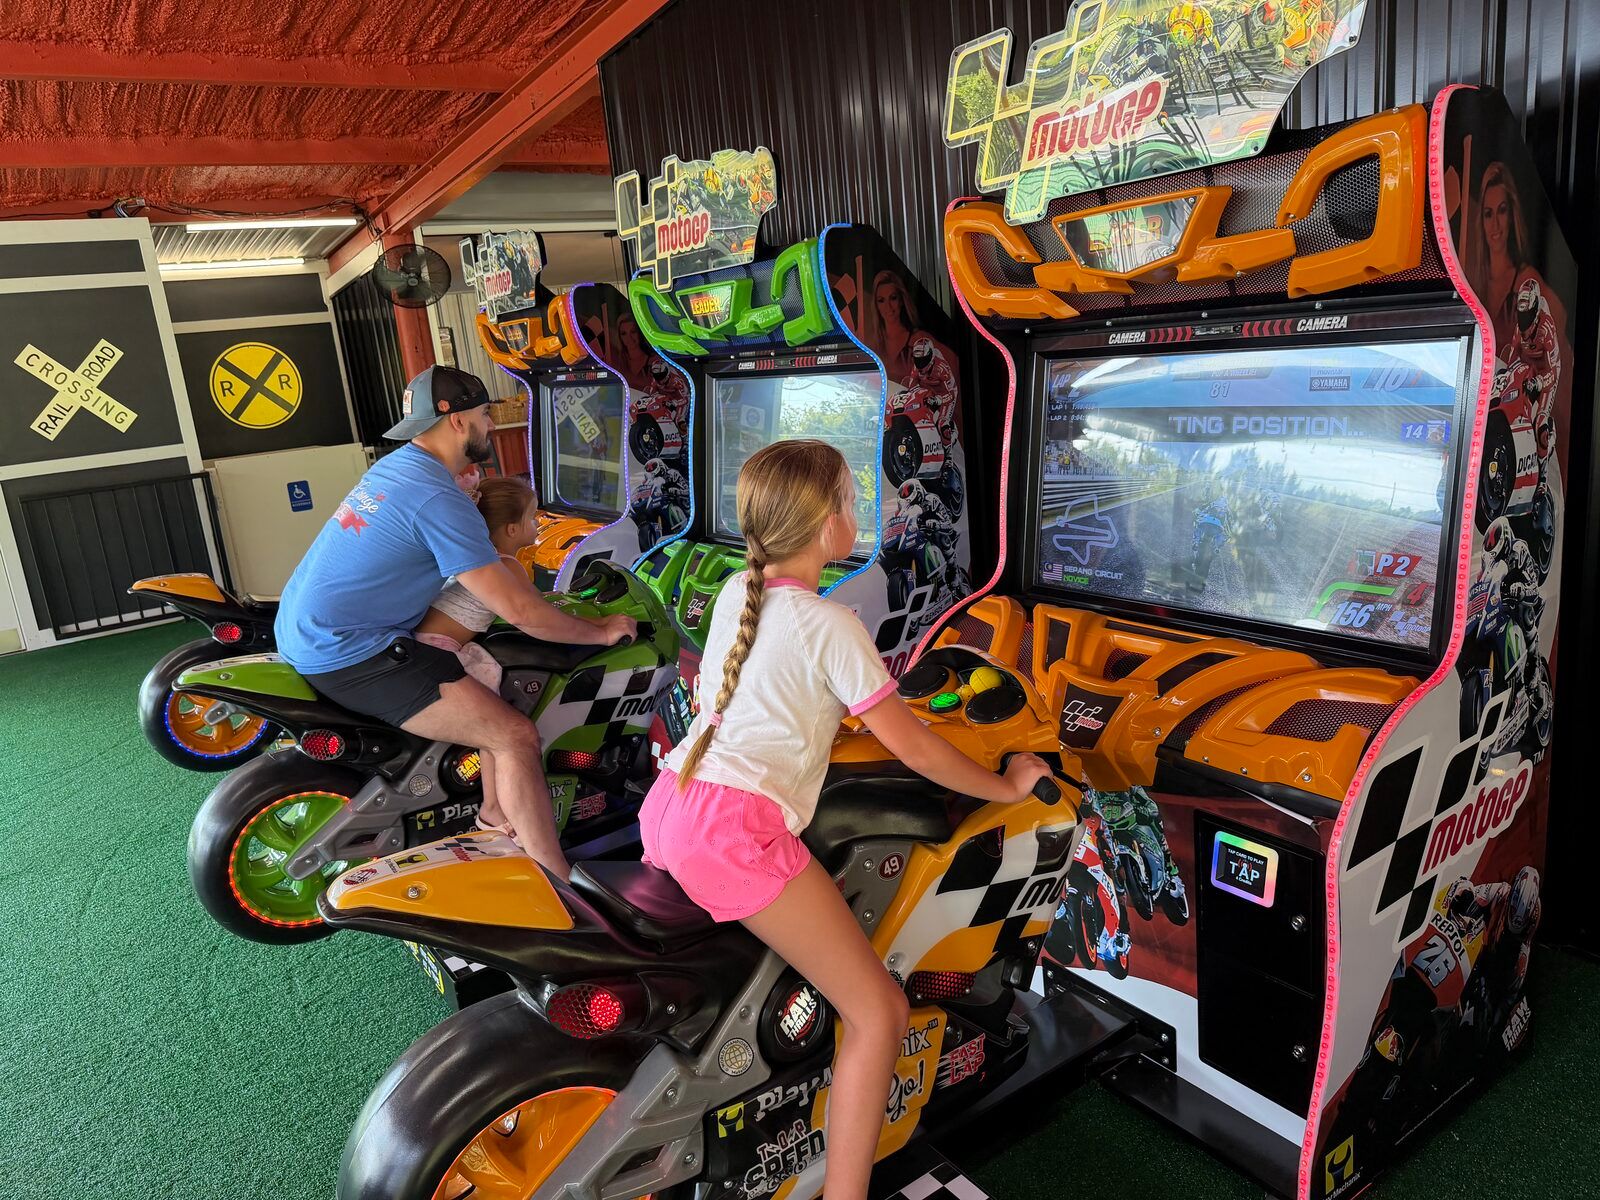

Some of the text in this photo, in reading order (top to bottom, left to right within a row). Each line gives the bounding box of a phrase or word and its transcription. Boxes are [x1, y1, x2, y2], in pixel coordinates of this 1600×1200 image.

[1296, 316, 1349, 331] CAMERA
[1108, 331, 1146, 345] CAMERA
[738, 362, 756, 370] CAMERA
[816, 355, 838, 365] CAMERA
[25, 352, 129, 425] CROSSING
[38, 345, 116, 435] RAIL ROAD
[219, 380, 235, 397] R
[278, 373, 293, 391] R
[1319, 379, 1349, 388] YAMAHA
[1404, 424, 1423, 439] 14
[1063, 575, 1089, 585] NOVICE
[1064, 565, 1123, 580] SEPANG CIRCUIT
[1407, 582, 1430, 606] 4
[1330, 601, 1392, 628] 156 MPH
[526, 681, 540, 693] 49
[456, 752, 481, 777] RAW
[1533, 748, 1546, 766] TM
[883, 856, 900, 875] 49
[1229, 861, 1260, 881] TAP
[1431, 912, 1465, 962] REPSOL
[1415, 934, 1456, 988] 26
[779, 985, 815, 1036] RAW
[787, 998, 818, 1042] THRILLS
[1501, 995, 1531, 1046] RAW
[949, 1033, 986, 1061] FAST
[949, 1052, 985, 1085] LAP
